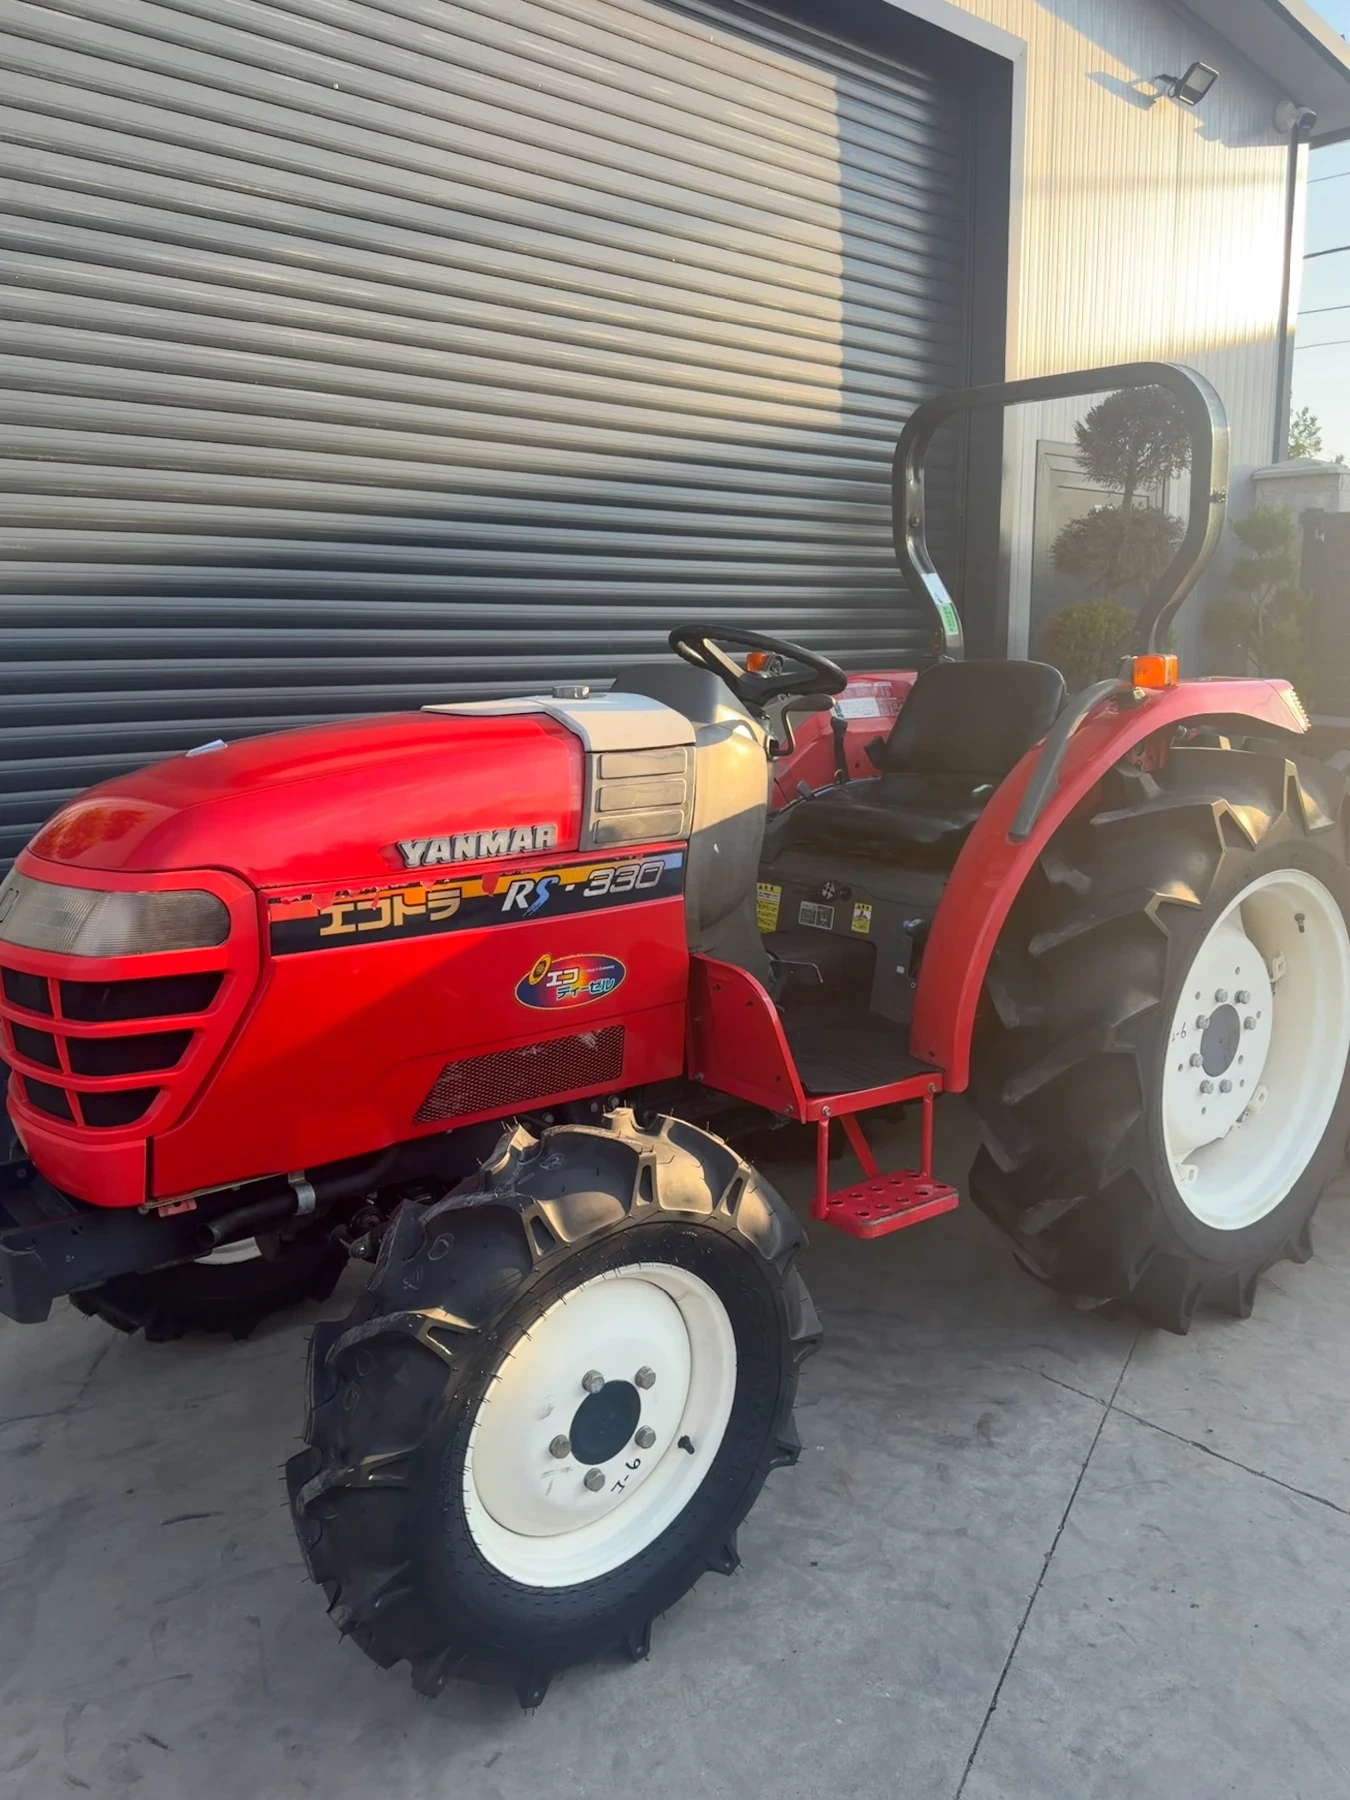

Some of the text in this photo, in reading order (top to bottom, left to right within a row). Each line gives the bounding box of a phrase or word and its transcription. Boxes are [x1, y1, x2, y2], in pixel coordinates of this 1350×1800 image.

[398, 823, 557, 868] YANMAR
[319, 888, 462, 937] エコトラ
[545, 967, 580, 988] エコ
